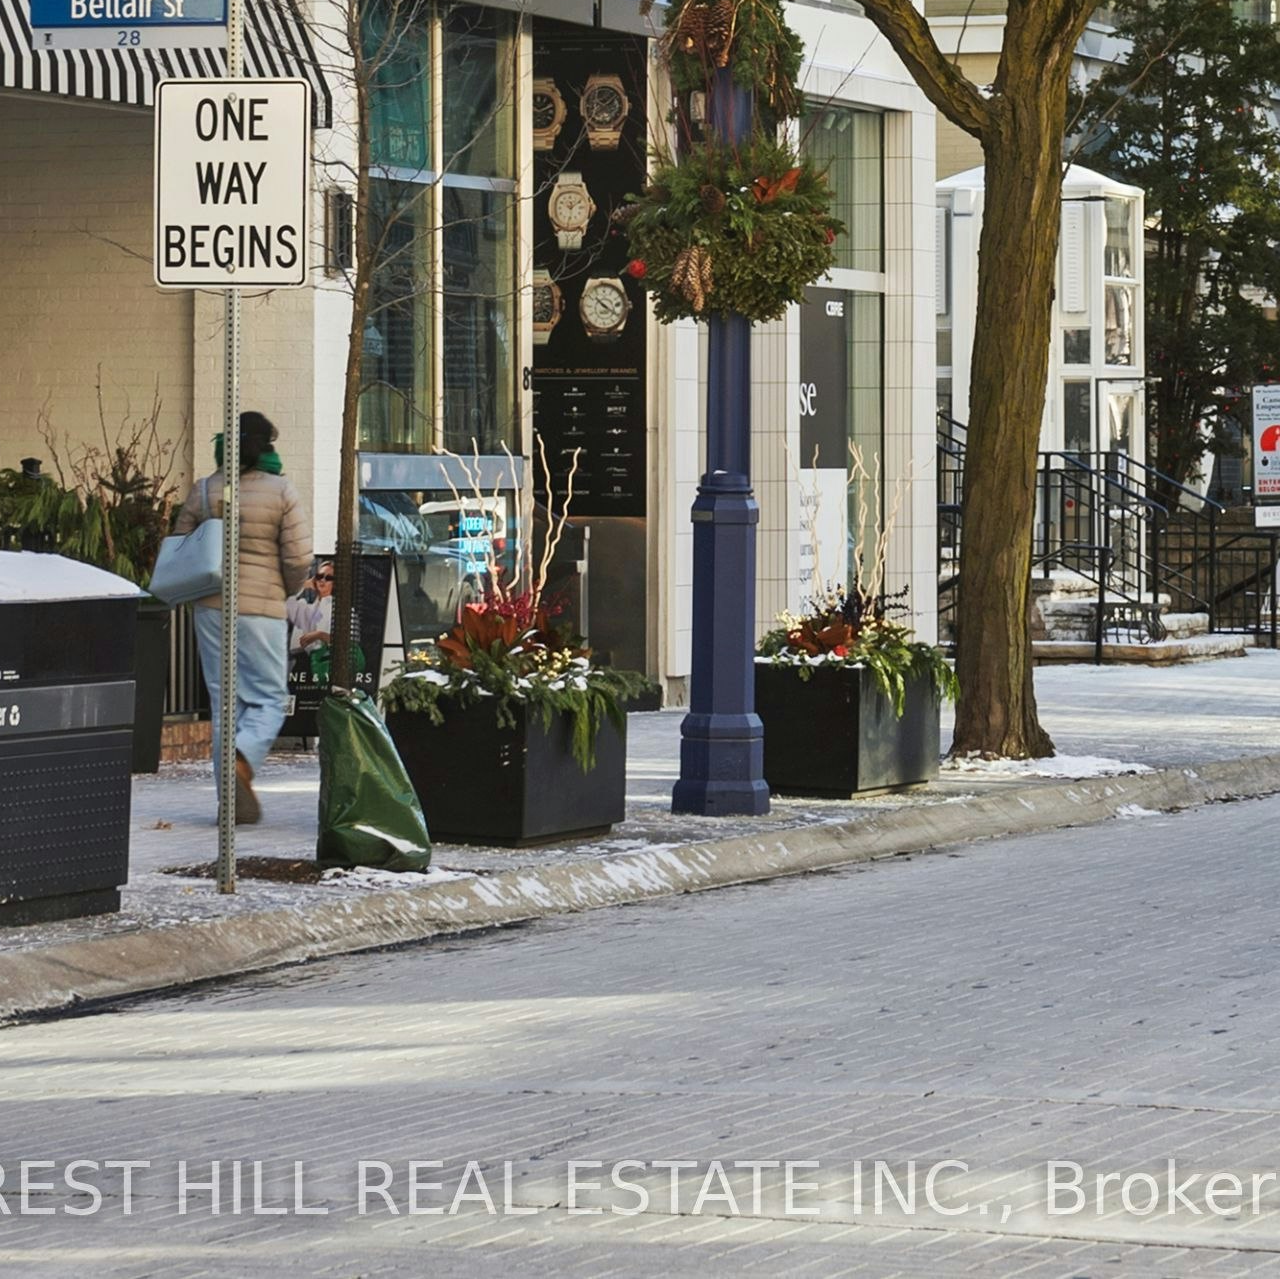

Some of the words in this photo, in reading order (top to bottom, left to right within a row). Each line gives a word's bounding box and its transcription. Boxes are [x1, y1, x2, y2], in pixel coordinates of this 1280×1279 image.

[117, 31, 141, 47] 28
[195, 98, 269, 142] ONE
[196, 161, 267, 205] WAY
[165, 224, 298, 269] BEGINS
[825, 300, 844, 318] CBRE
